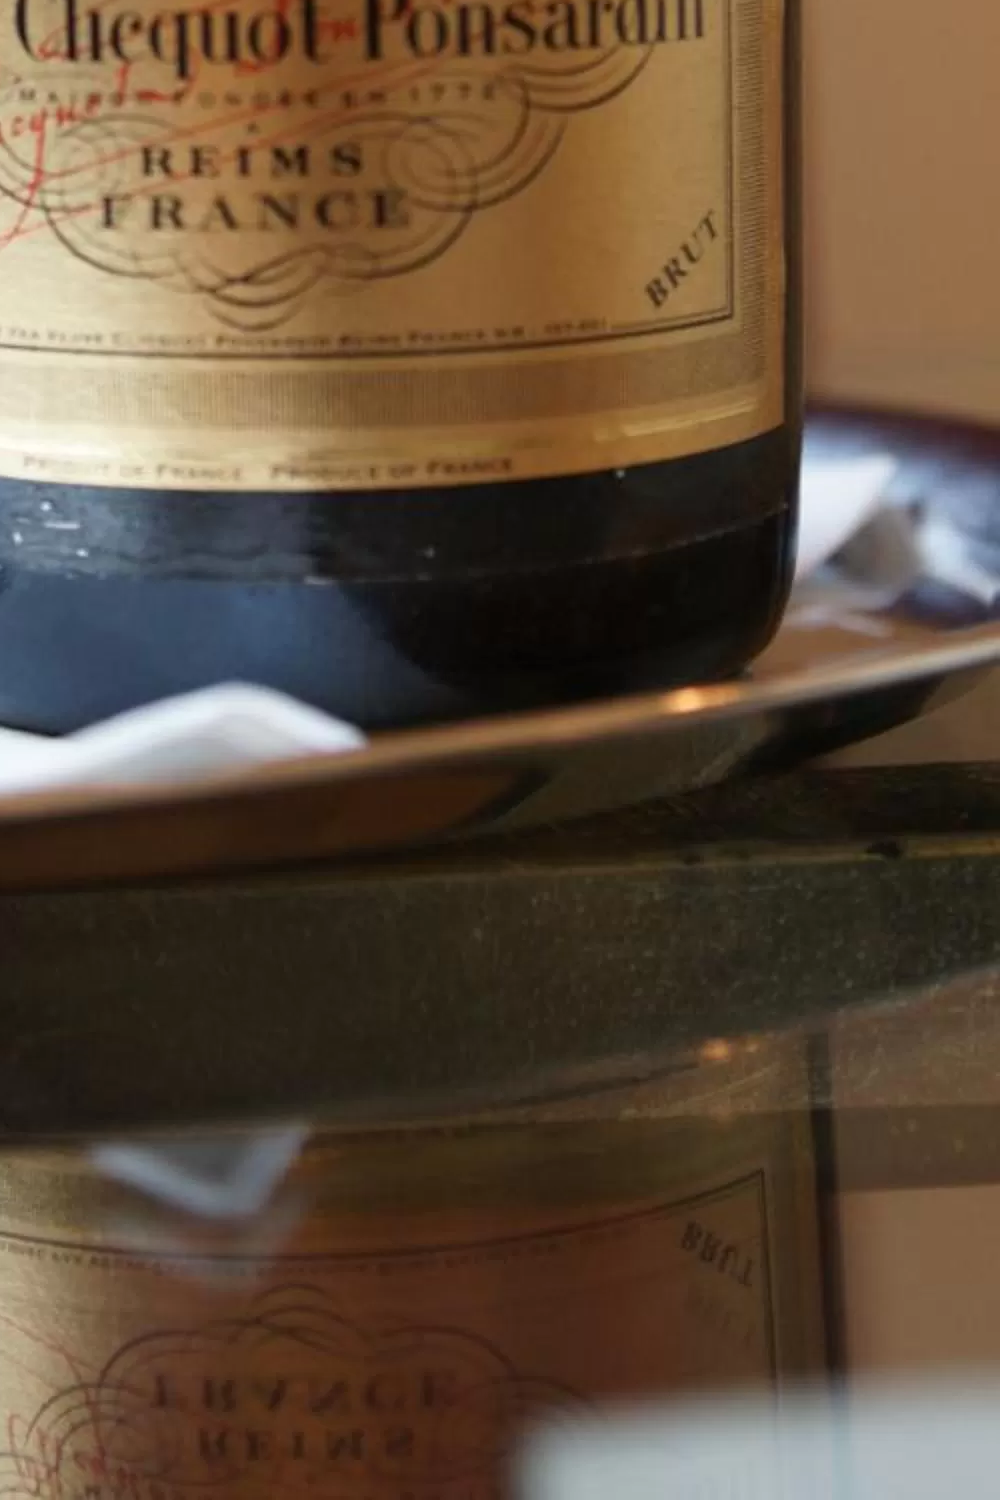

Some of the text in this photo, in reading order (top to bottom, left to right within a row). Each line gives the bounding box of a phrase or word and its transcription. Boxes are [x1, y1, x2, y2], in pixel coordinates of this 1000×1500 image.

[141, 143, 363, 180] REIMS
[100, 188, 409, 230] FRANCE
[643, 208, 722, 309] BRUT
